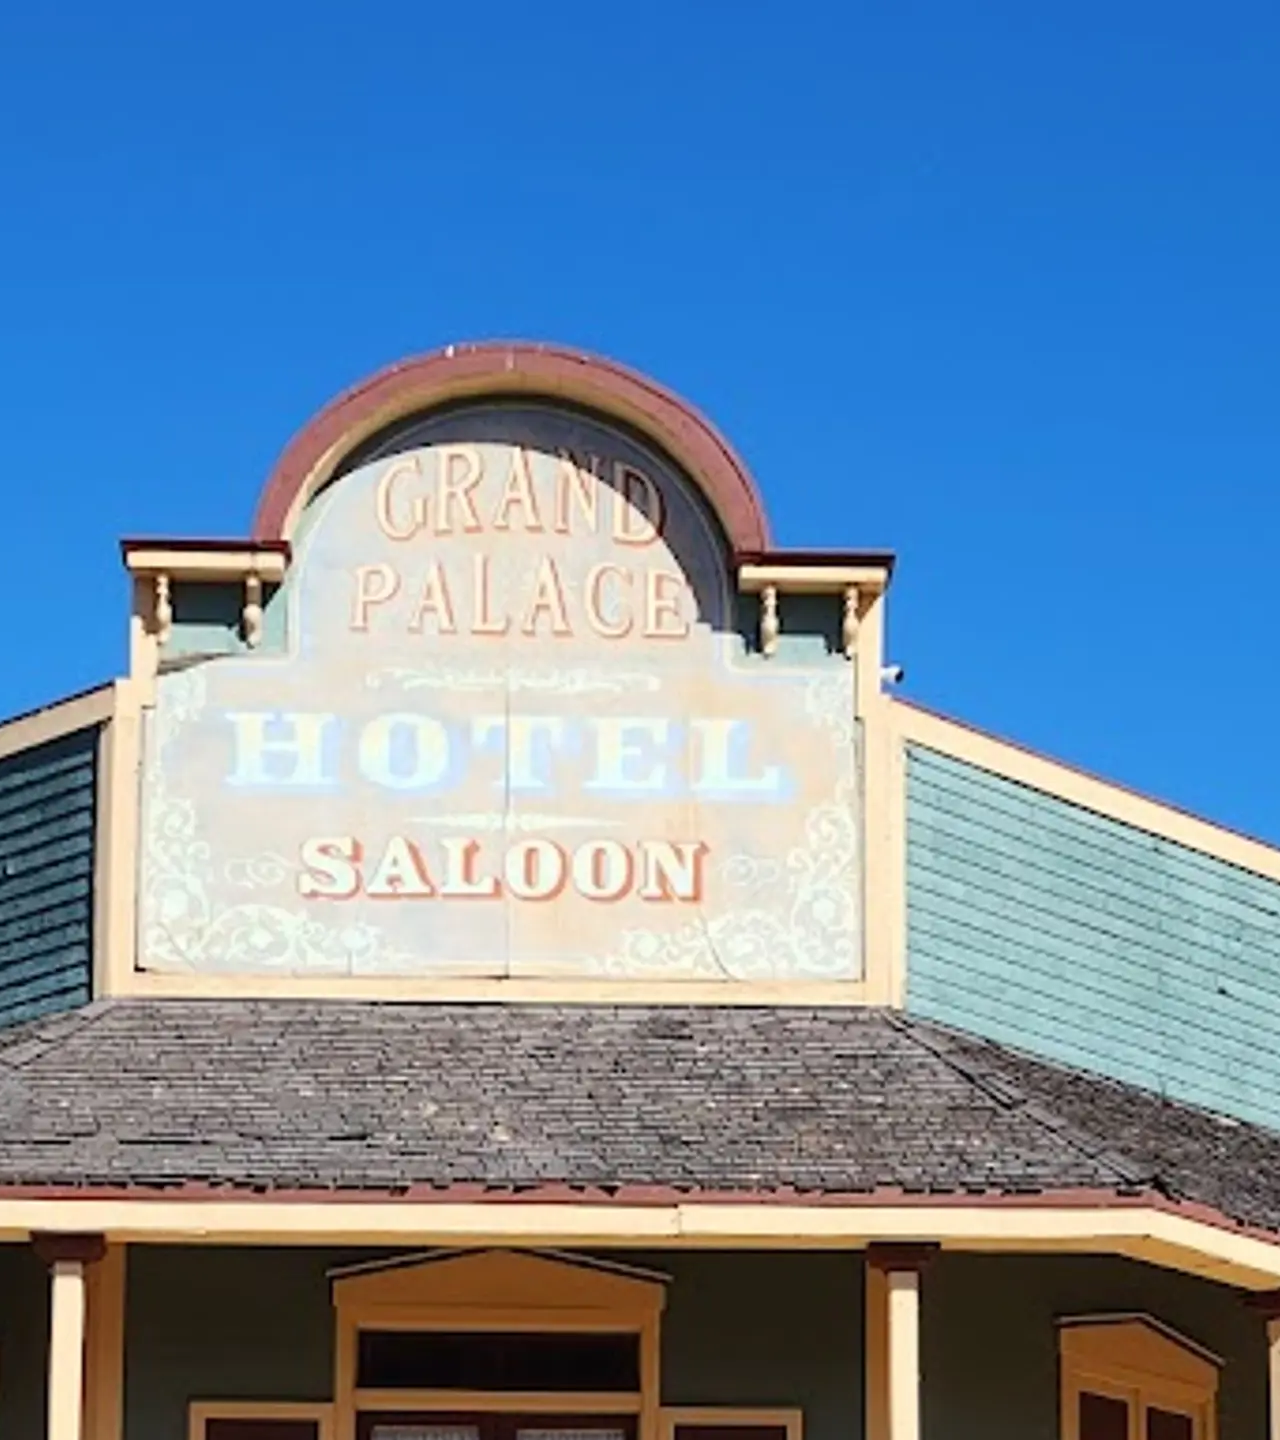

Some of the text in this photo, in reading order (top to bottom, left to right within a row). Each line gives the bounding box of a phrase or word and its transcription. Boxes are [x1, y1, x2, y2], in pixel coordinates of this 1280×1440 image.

[375, 444, 667, 548] GRAND
[347, 551, 692, 640] PALACE
[221, 708, 798, 804] HOTEL
[297, 834, 711, 903] SALOON
